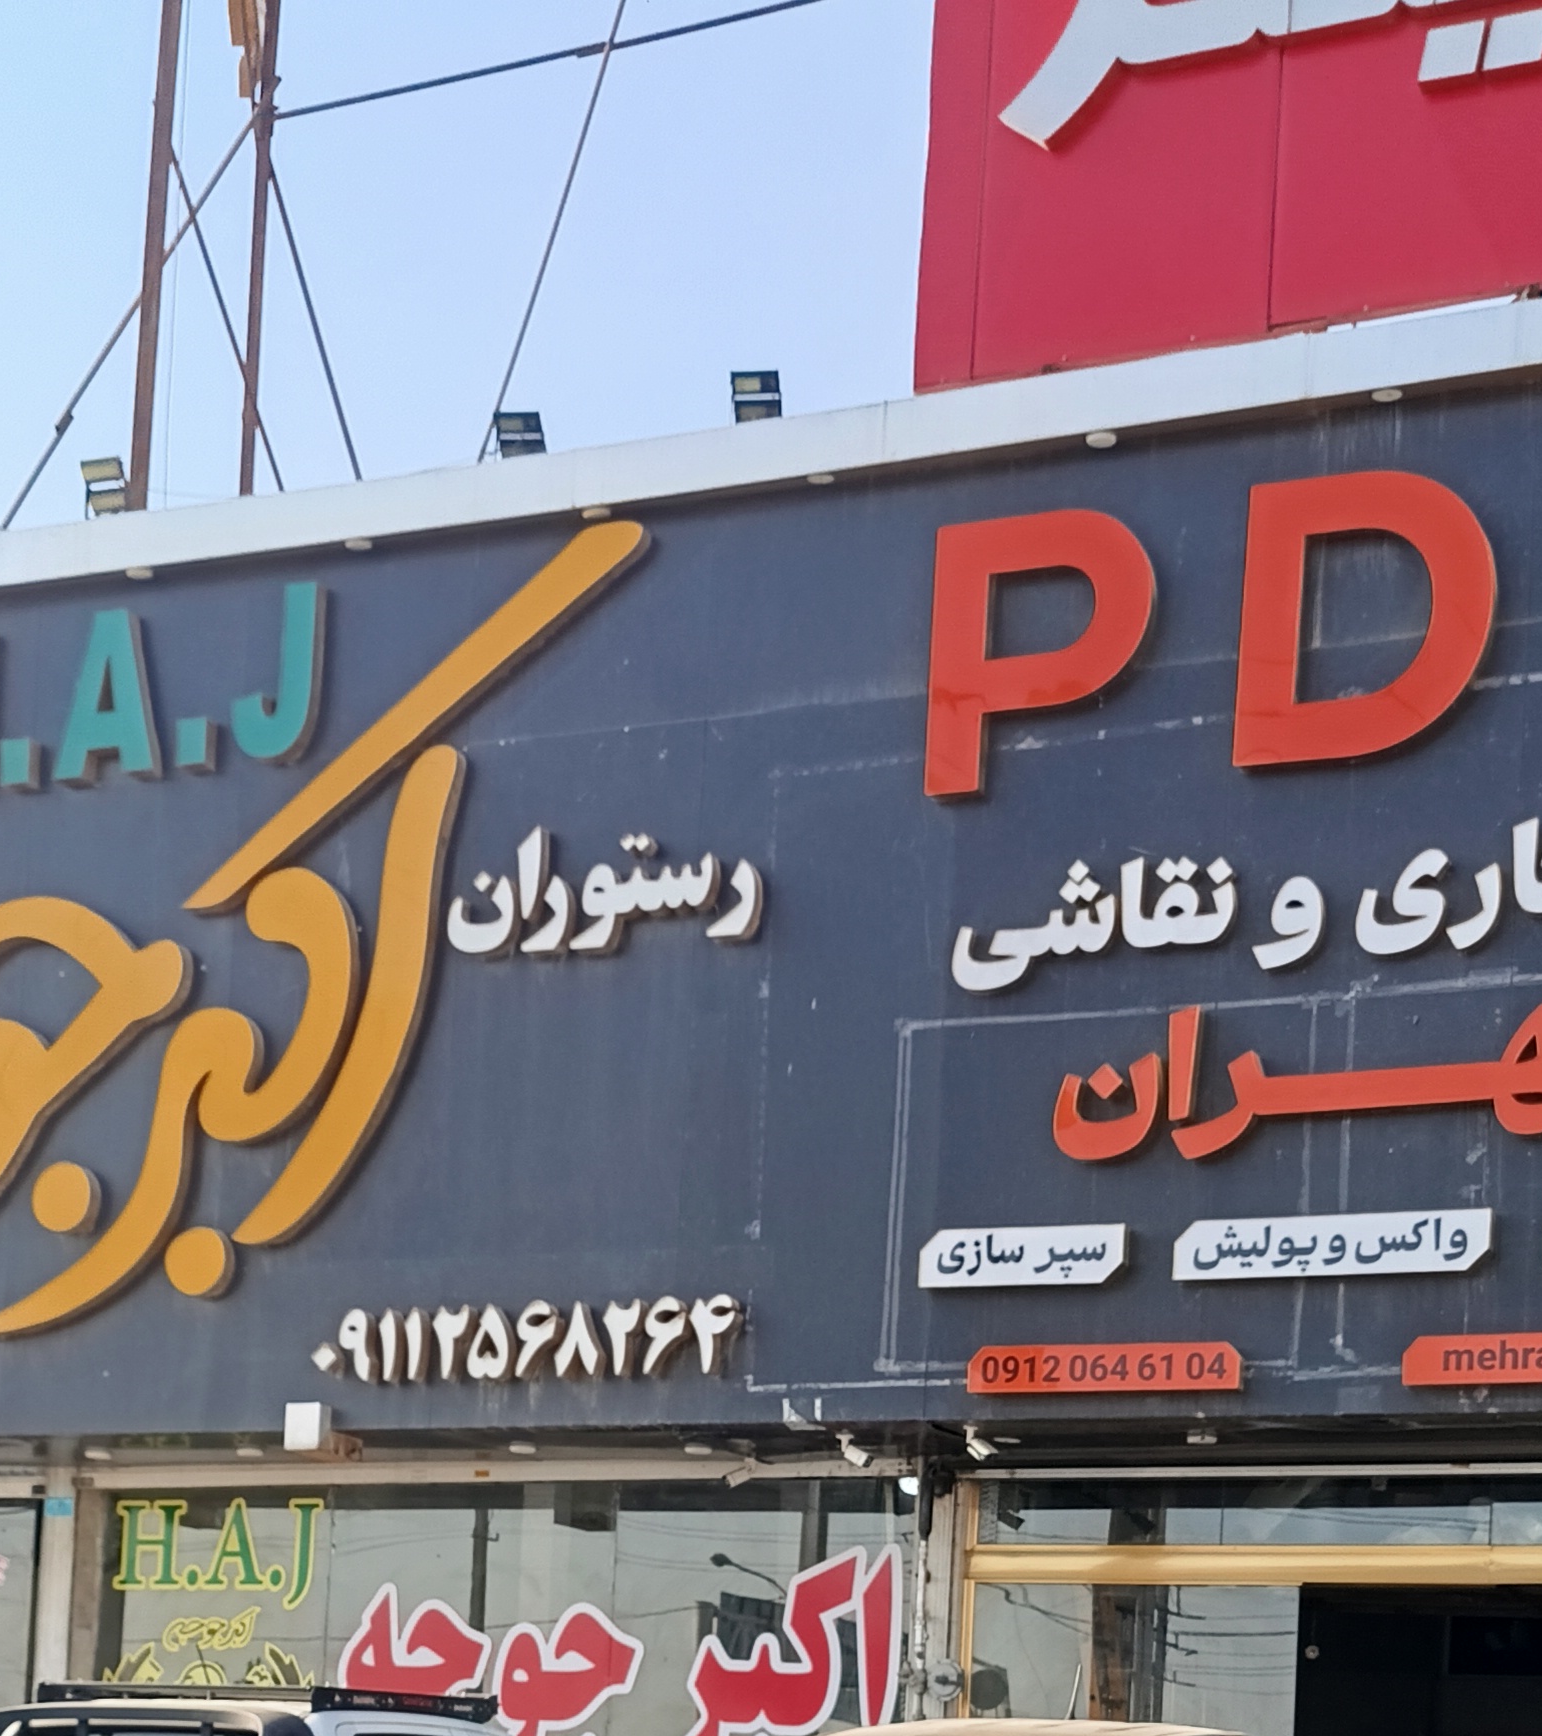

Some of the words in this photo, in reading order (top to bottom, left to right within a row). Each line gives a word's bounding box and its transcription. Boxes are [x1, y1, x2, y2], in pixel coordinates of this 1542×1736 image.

[446, 825, 763, 955] رستوران
[950, 852, 1237, 991] نقاشی
[1252, 872, 1325, 970] و
[936, 1233, 1025, 1277] سازی
[1033, 1240, 1107, 1279] سپر
[1192, 1224, 1318, 1273] پولیش
[1322, 1232, 1347, 1266] و
[1354, 1217, 1469, 1265] واکس
[310, 1293, 737, 1383] ۰۹۱۱۲۵۶۸۲۶۴
[981, 1355, 1061, 1384] 0912
[1068, 1353, 1129, 1382] 064
[1137, 1352, 1174, 1381] 61
[1186, 1350, 1228, 1380] 04
